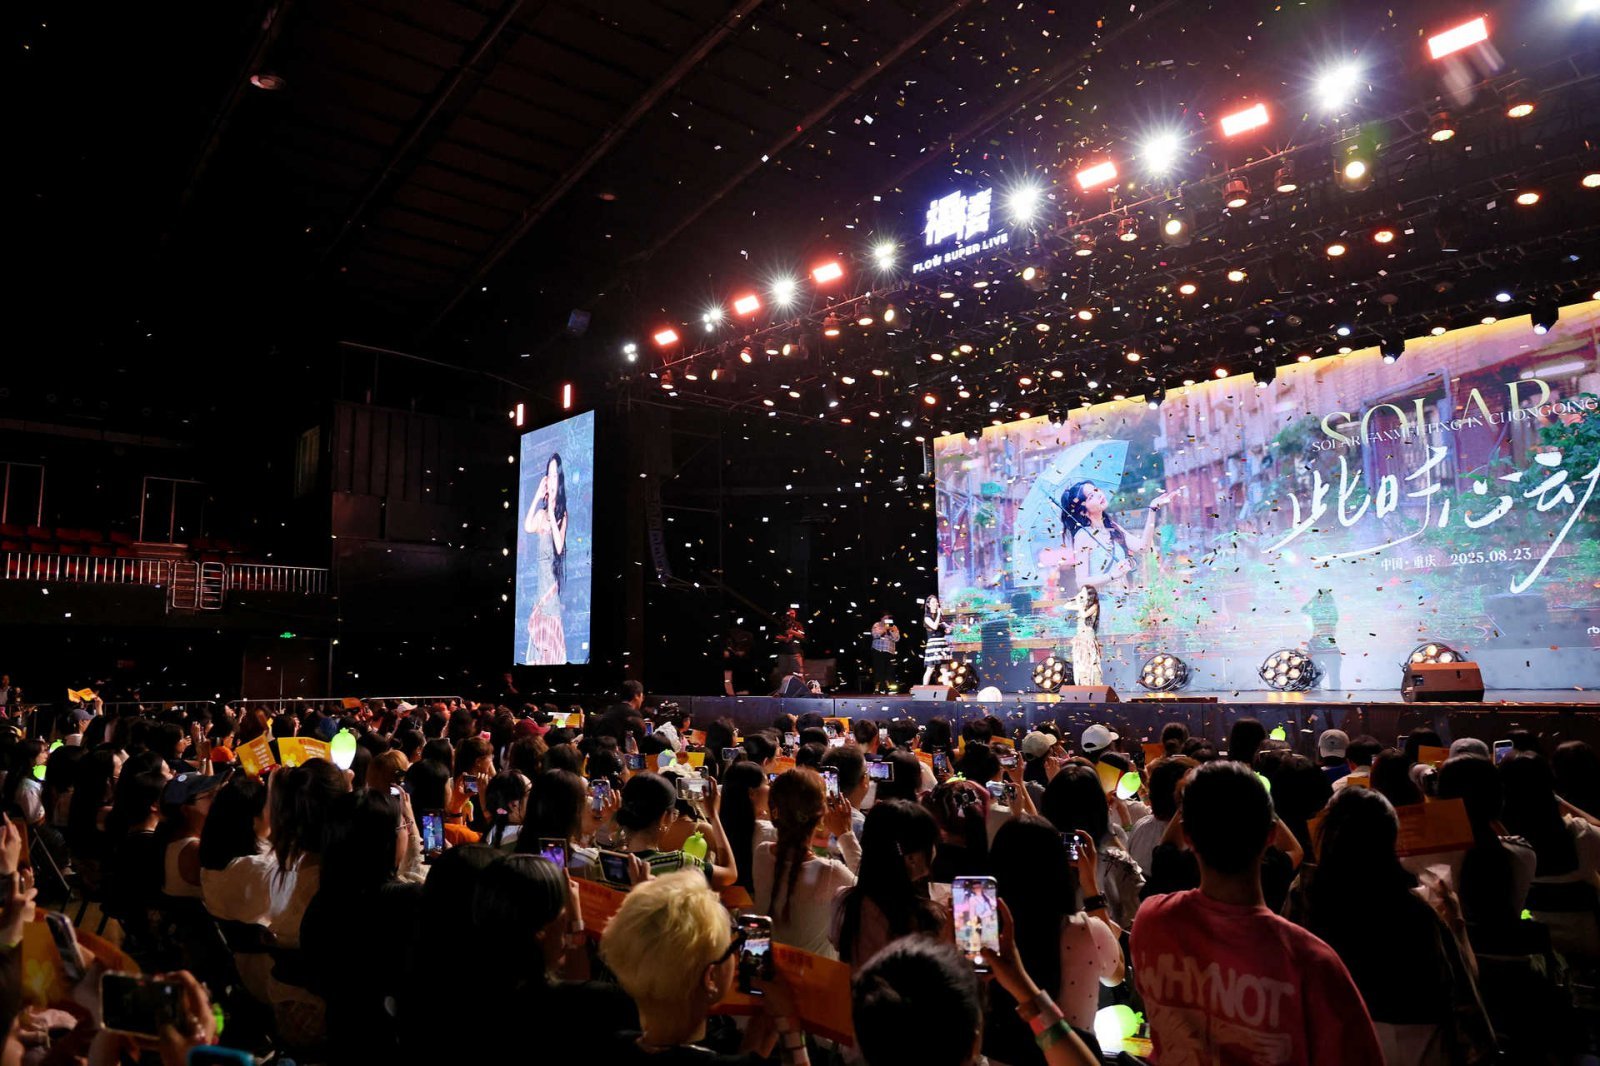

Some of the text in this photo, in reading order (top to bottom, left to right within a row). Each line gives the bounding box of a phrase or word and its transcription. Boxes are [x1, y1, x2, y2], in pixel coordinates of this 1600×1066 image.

[912, 233, 1009, 274] FLOW SUPER LIVE
[1311, 436, 1361, 452] SOLAR
[1466, 415, 1484, 428] IN
[1450, 547, 1532, 566] 2025.08.23
